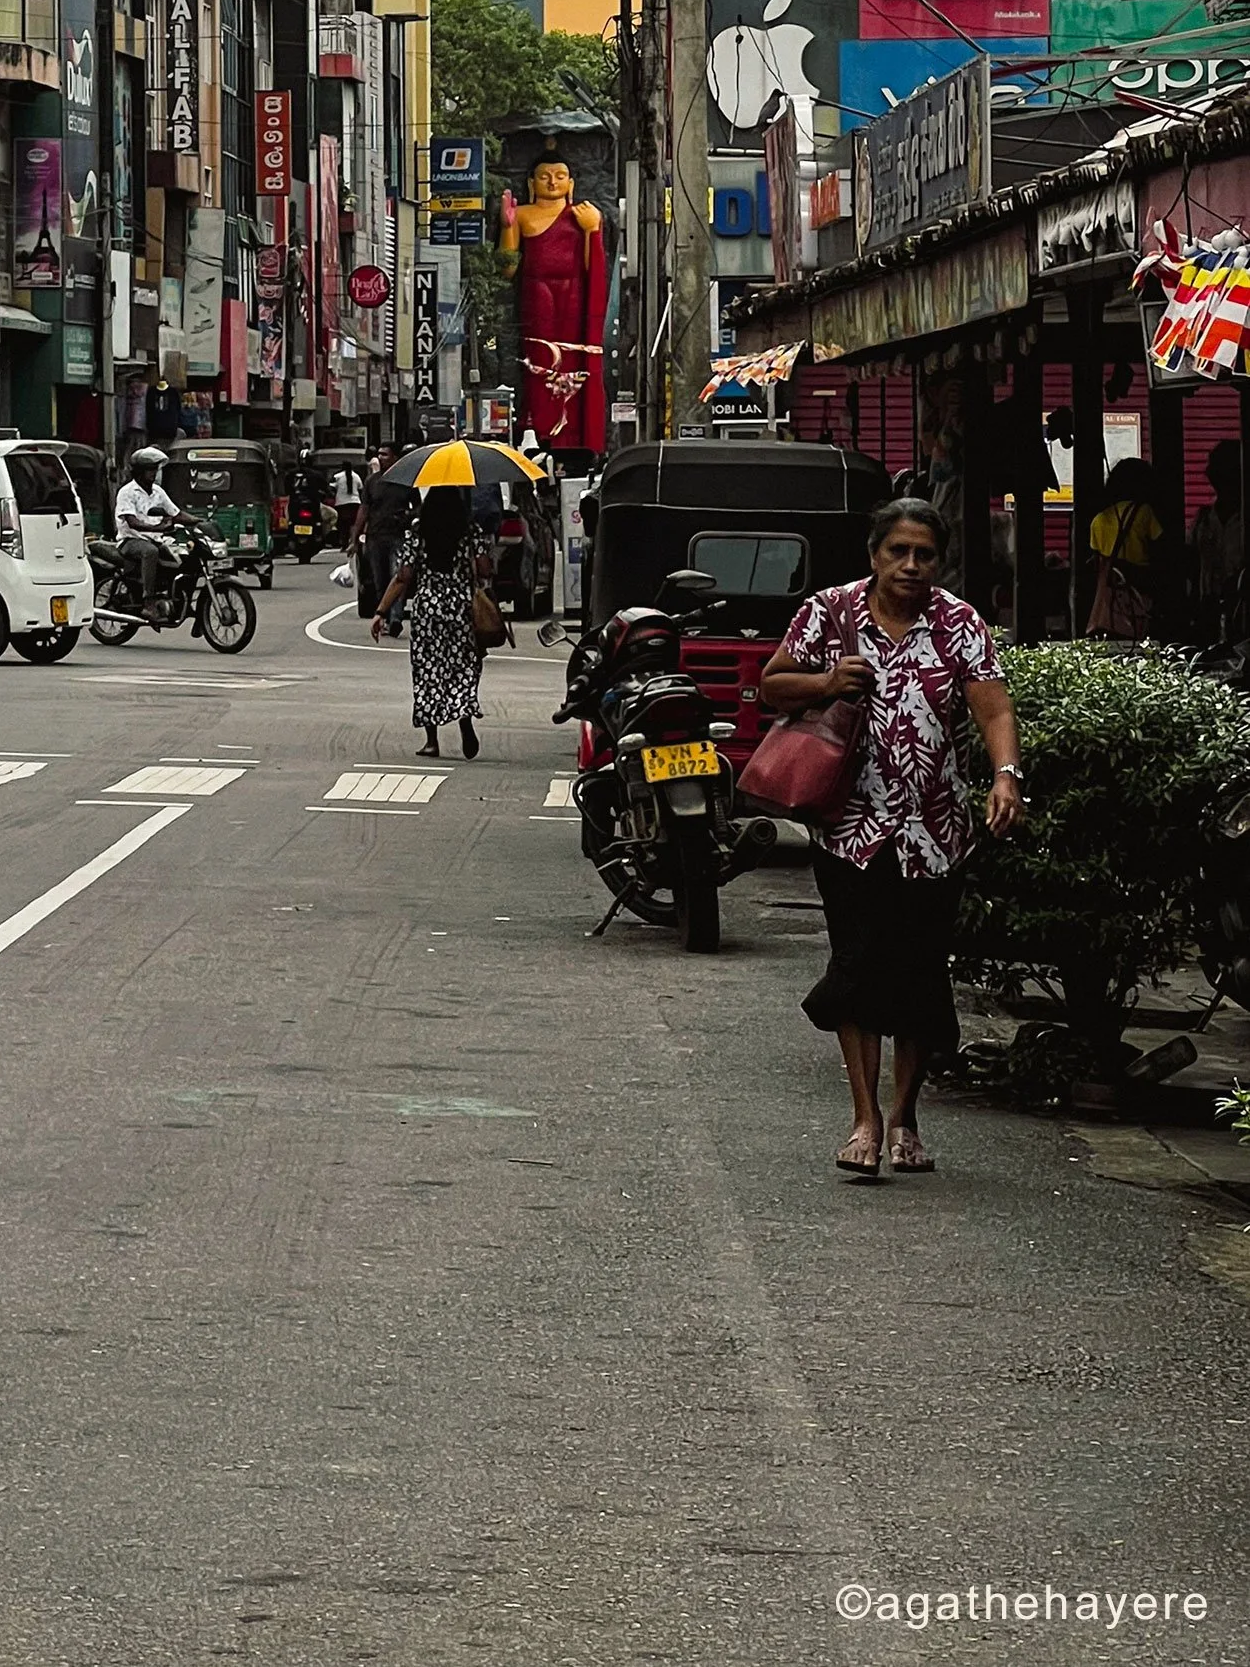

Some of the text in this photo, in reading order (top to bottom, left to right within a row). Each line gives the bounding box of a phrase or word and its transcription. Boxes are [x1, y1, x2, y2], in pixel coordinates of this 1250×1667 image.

[67, 61, 92, 106] Dulux
[171, 67, 193, 150] FAB
[416, 273, 435, 402] NILANTHA
[712, 405, 735, 415] OBI
[667, 759, 710, 777] 8872
[669, 747, 693, 760] VN
